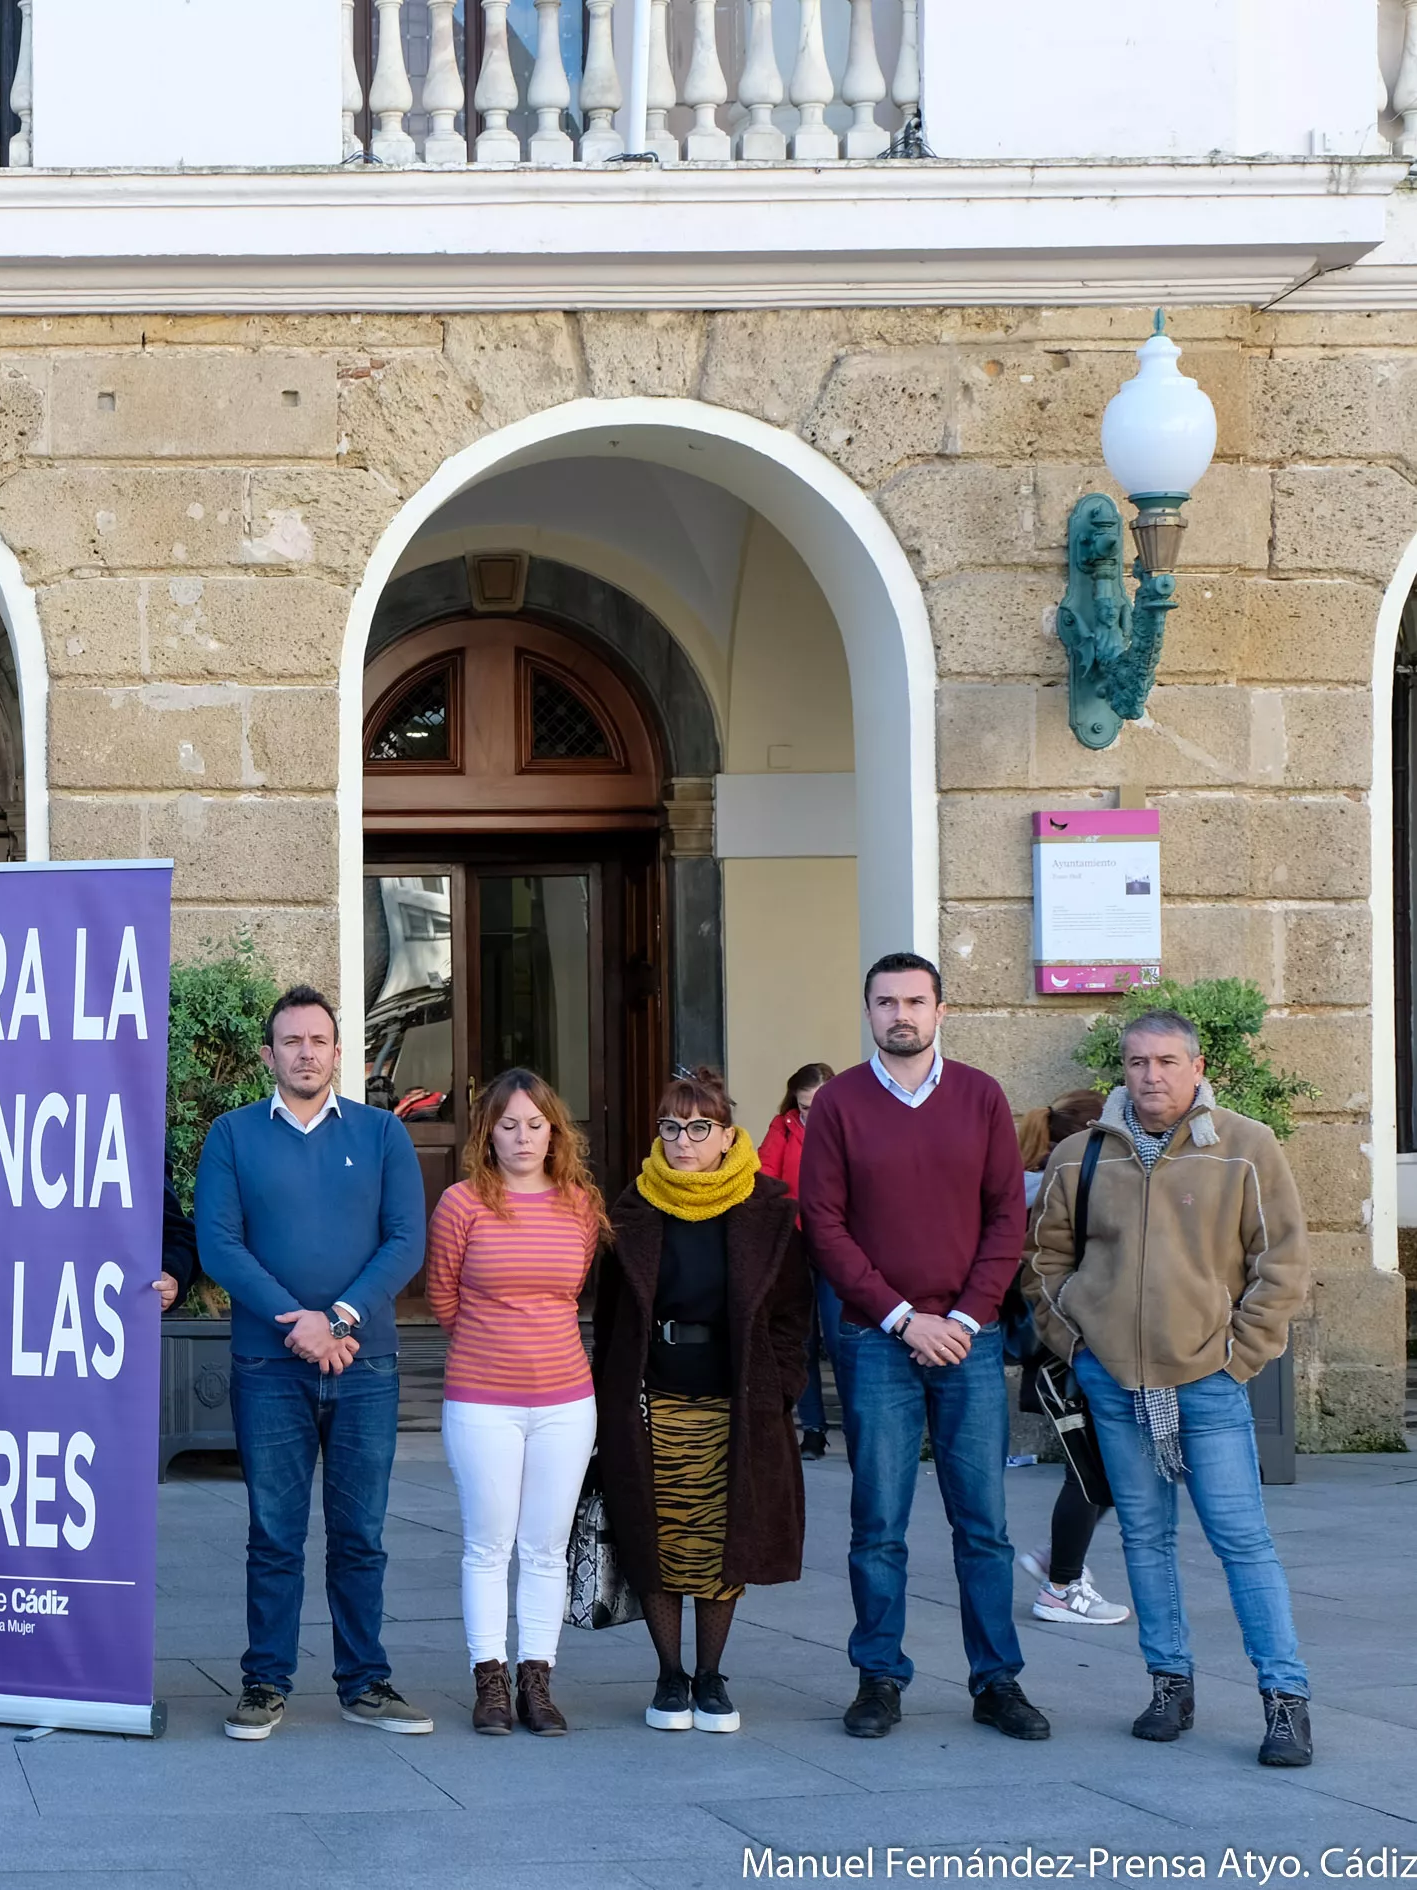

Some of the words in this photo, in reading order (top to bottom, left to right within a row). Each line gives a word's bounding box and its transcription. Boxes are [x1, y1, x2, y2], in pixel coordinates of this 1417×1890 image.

[1051, 857, 1117, 870] Ayuntamiento
[72, 925, 149, 1041] LA
[11, 1260, 125, 1380] LAS
[11, 1587, 69, 1616] Cádiz
[7, 1619, 36, 1636] Mujer
